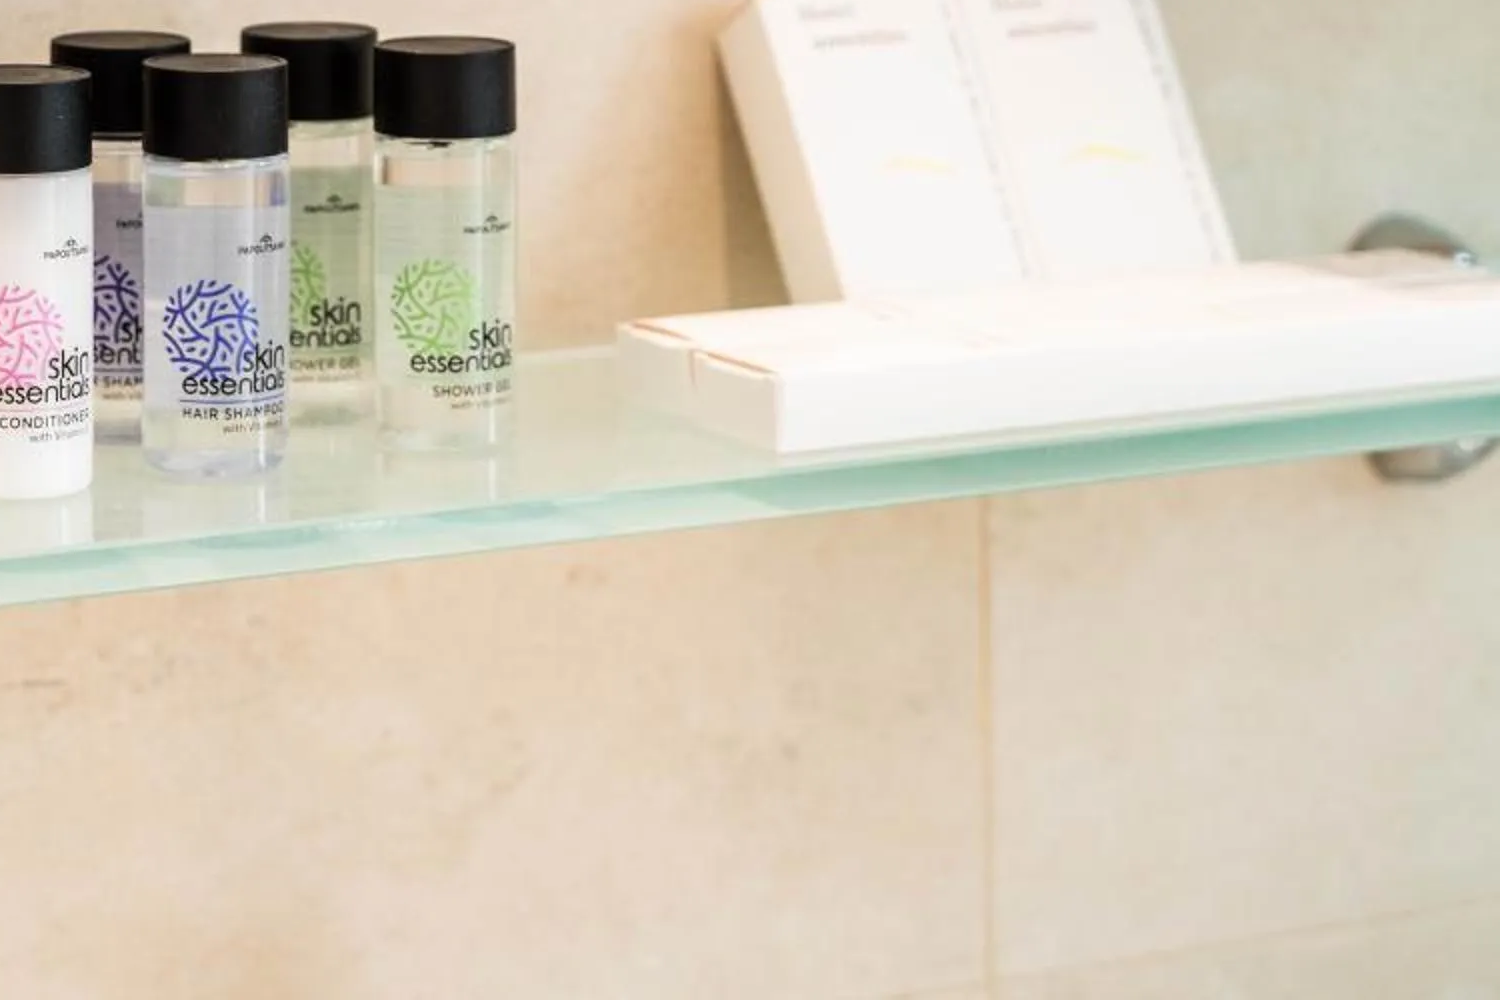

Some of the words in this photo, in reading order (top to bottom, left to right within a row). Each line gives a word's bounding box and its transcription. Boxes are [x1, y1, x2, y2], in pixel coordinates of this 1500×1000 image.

[310, 296, 362, 327] skin
[289, 323, 362, 348] entials
[469, 319, 512, 351] skin
[48, 346, 89, 379] skin
[242, 340, 285, 373] skin
[182, 369, 285, 395] essentials
[182, 407, 220, 421] HAIR
